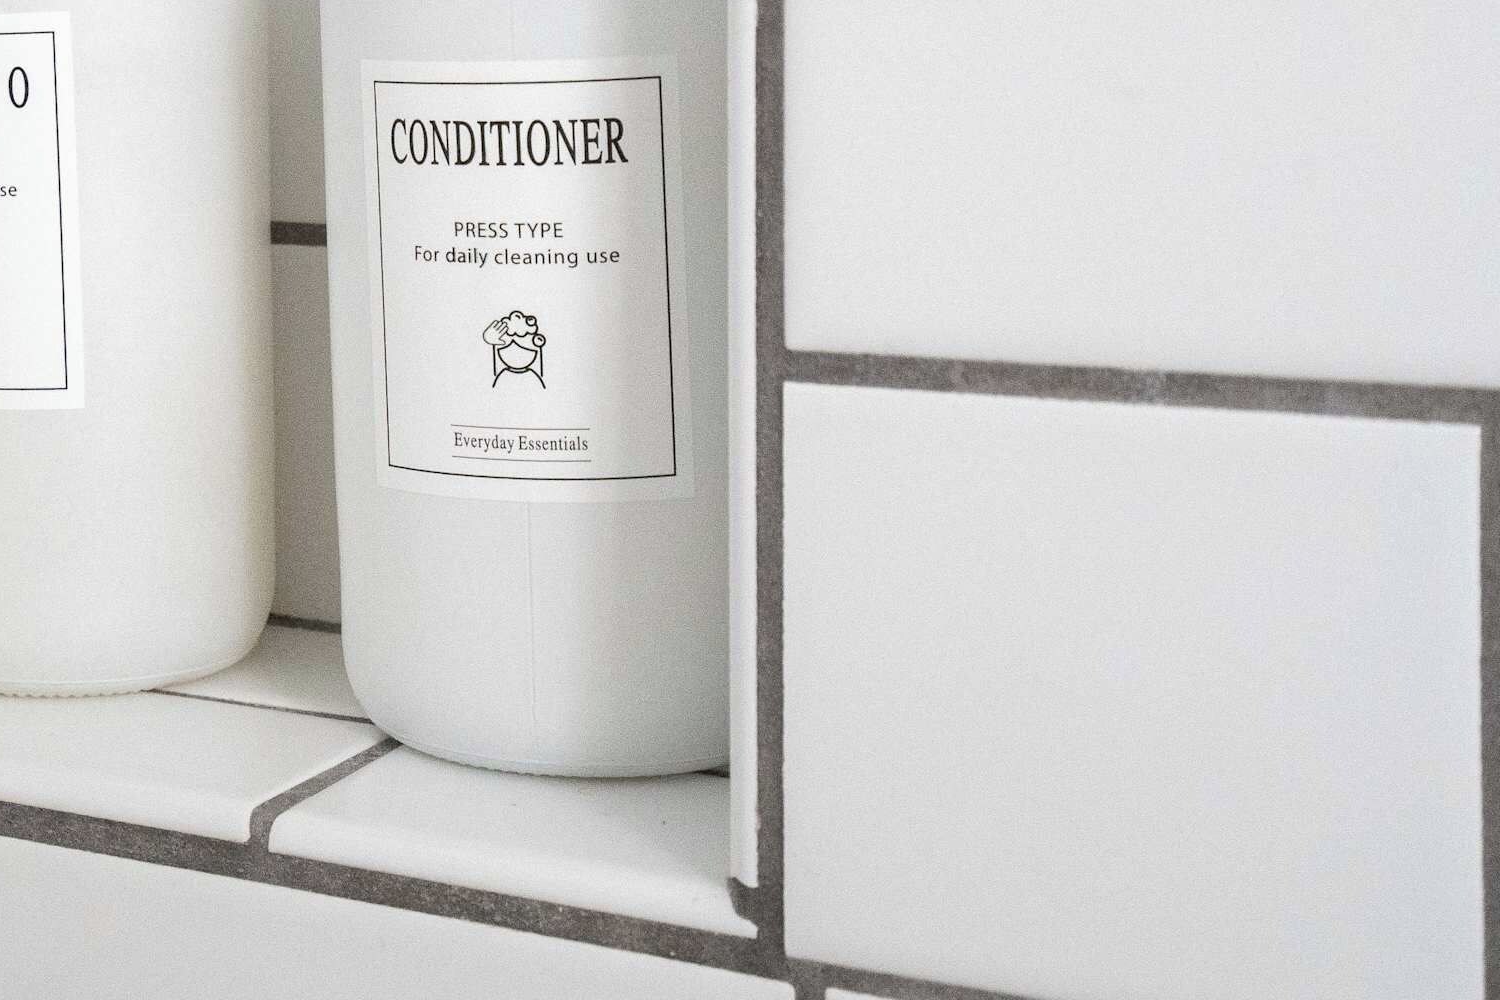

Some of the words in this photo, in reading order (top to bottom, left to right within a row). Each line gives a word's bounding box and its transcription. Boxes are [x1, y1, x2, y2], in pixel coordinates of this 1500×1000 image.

[390, 116, 629, 166] CONDITIONER
[454, 221, 509, 239] PRESS
[514, 222, 564, 238] TYPE
[414, 245, 439, 262] For
[445, 246, 488, 268] daily
[494, 247, 579, 268] cleaning
[586, 250, 621, 264] use
[453, 431, 515, 454] Everyday
[518, 434, 589, 452] Essentials
